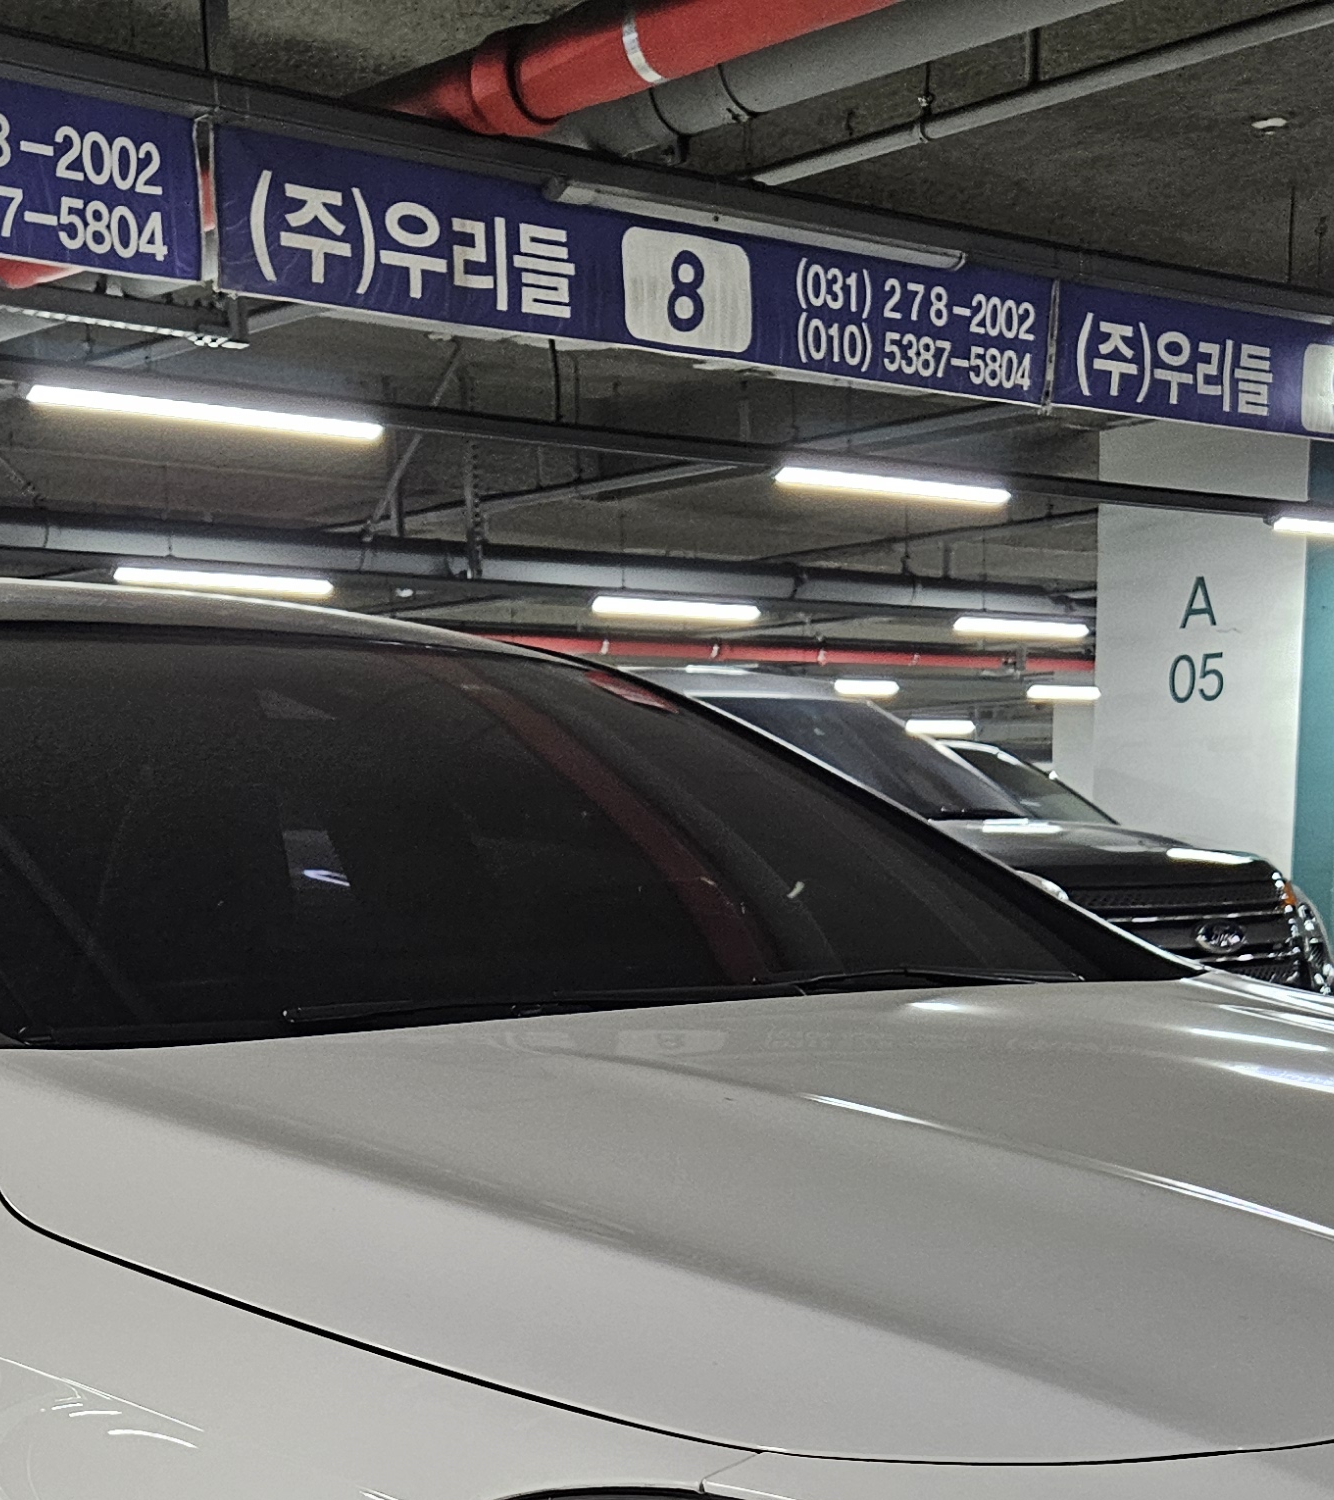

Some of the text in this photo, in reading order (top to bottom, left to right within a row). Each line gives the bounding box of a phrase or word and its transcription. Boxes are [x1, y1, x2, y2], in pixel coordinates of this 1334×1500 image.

[249, 169, 576, 318] (주)우리들
[668, 249, 704, 332] 8
[796, 257, 1036, 341] (031) 278-2002
[797, 312, 1032, 391] (010) 5387-5804
[1077, 312, 1273, 416] (주)우리들
[1179, 576, 1217, 629] A
[1169, 652, 1224, 703] 05
